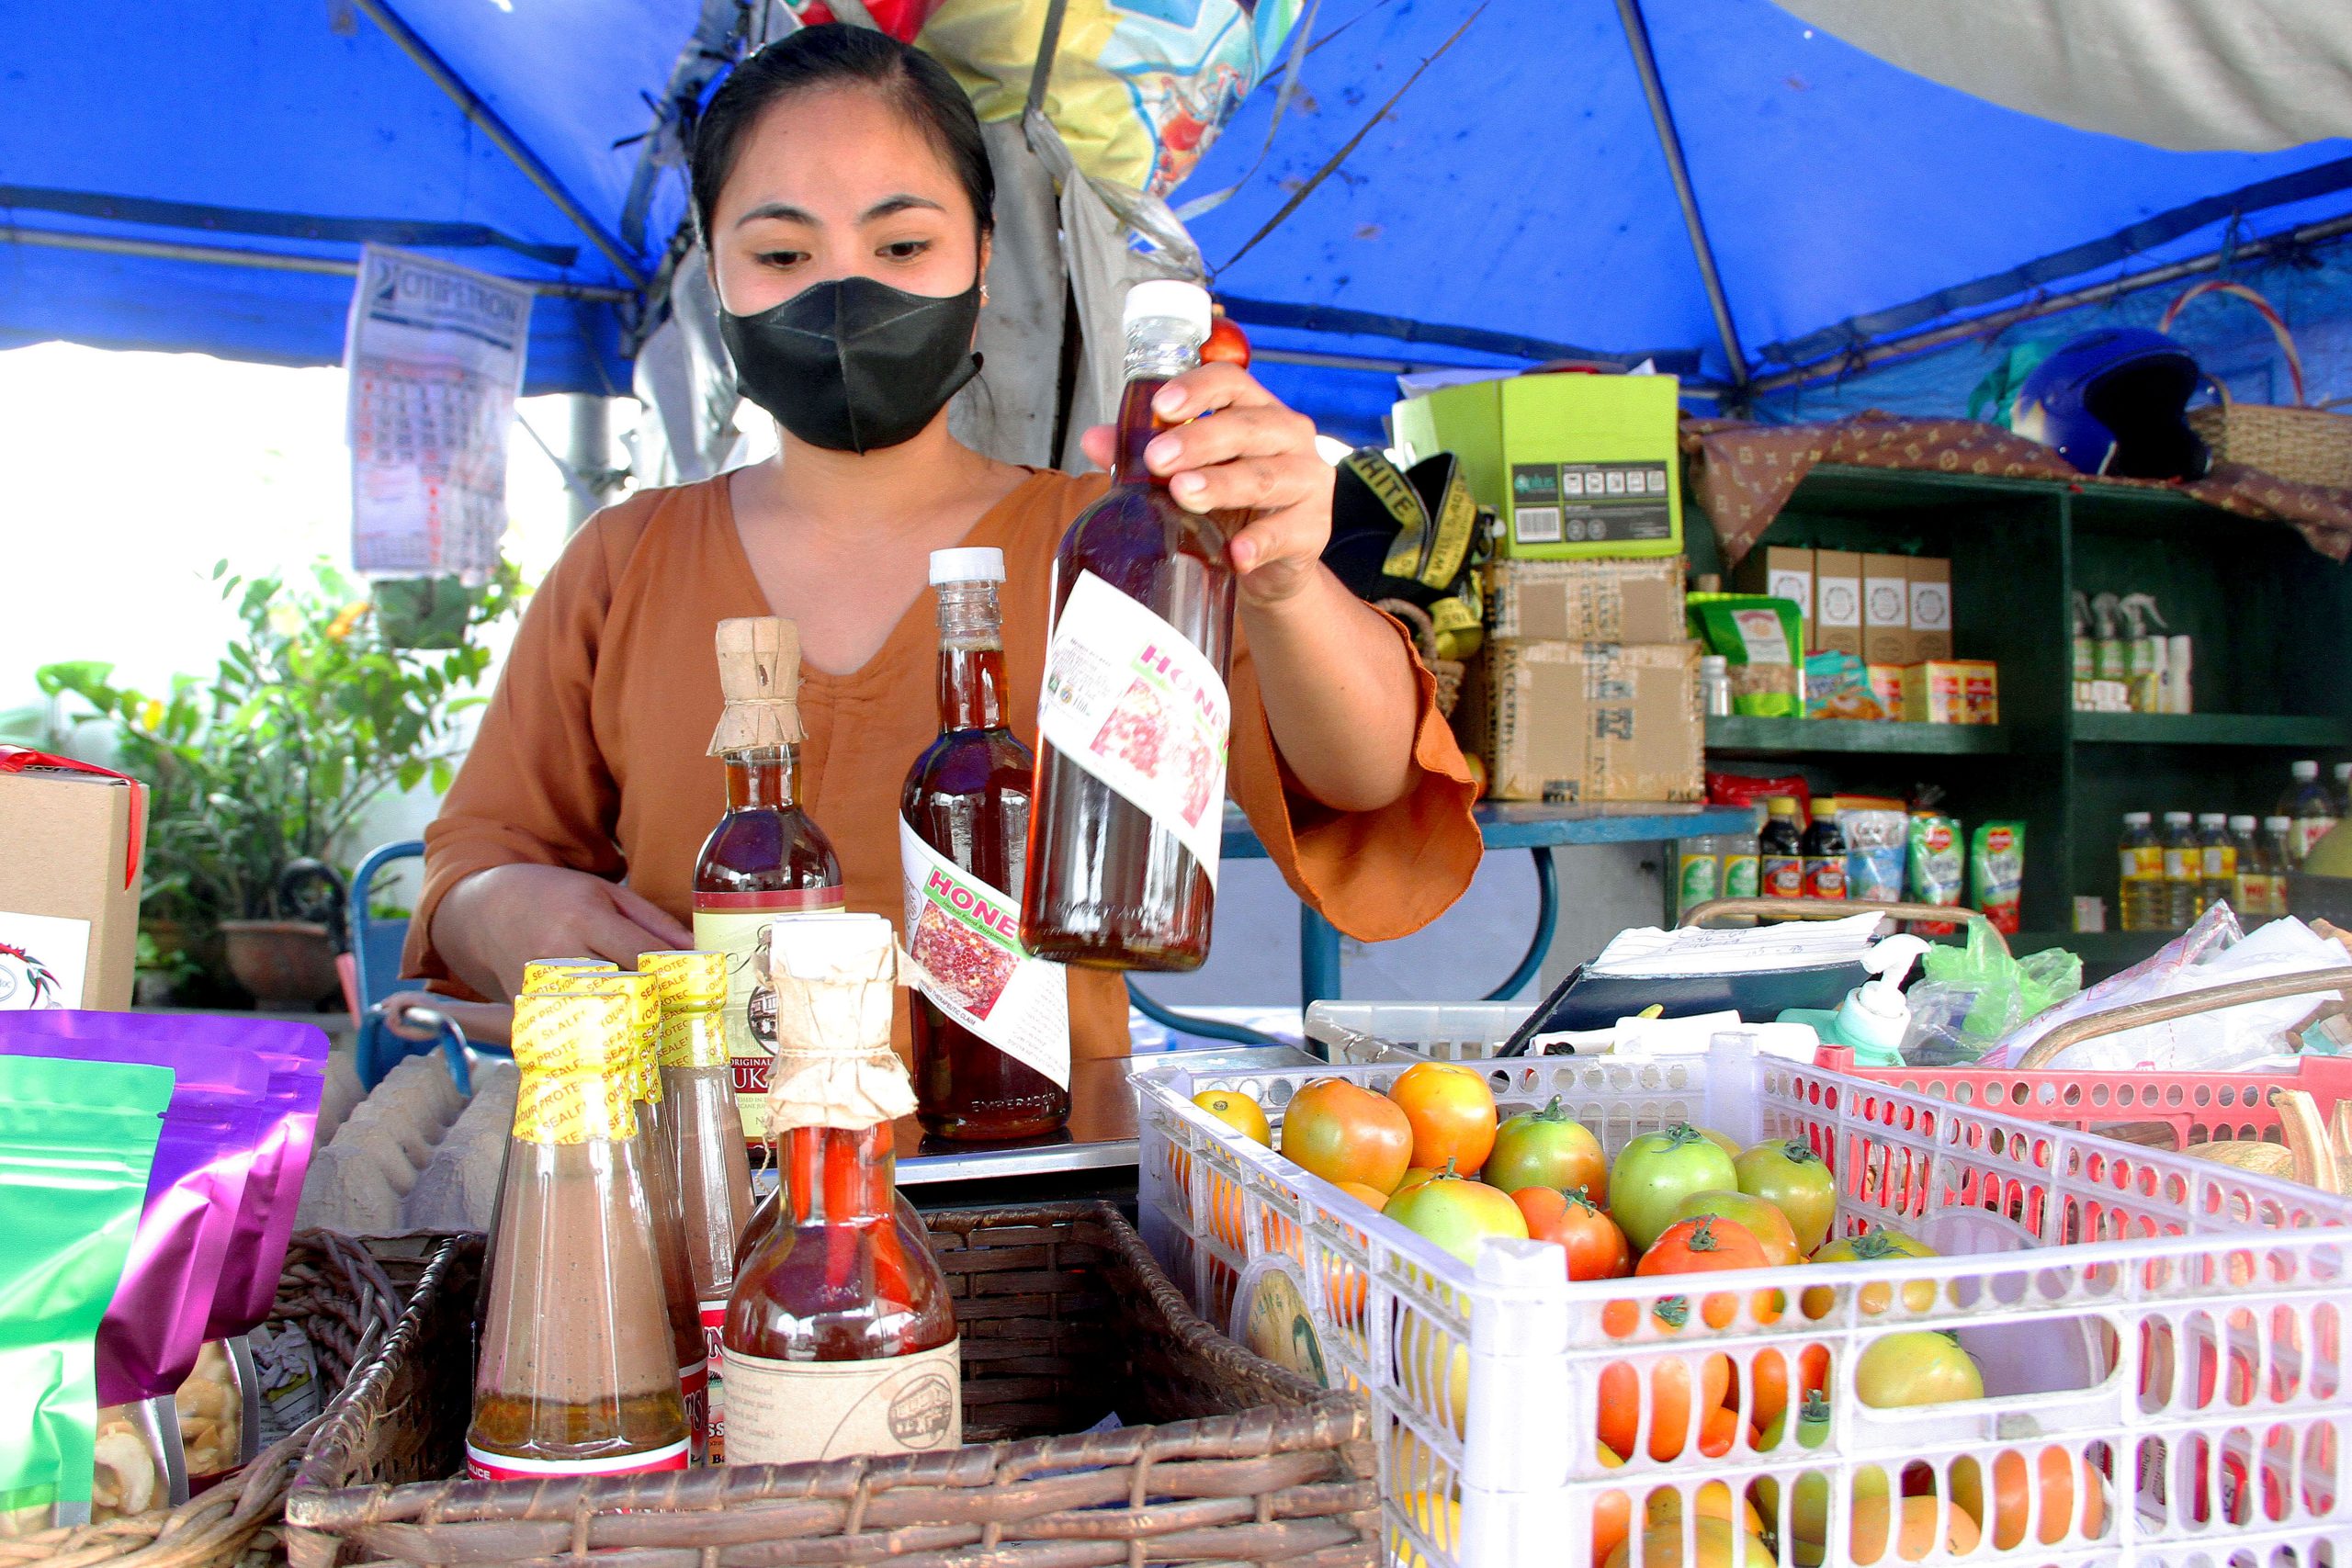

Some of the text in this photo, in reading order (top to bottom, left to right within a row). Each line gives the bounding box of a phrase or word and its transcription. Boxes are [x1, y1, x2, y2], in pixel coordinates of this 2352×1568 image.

[928, 870, 1019, 939] HONE
[943, 900, 1015, 949] Herbal Food Supplement
[932, 987, 961, 1017] THERAPEUTIC
[959, 1011, 977, 1027] CLAIM
[732, 1067, 770, 1089] UK
